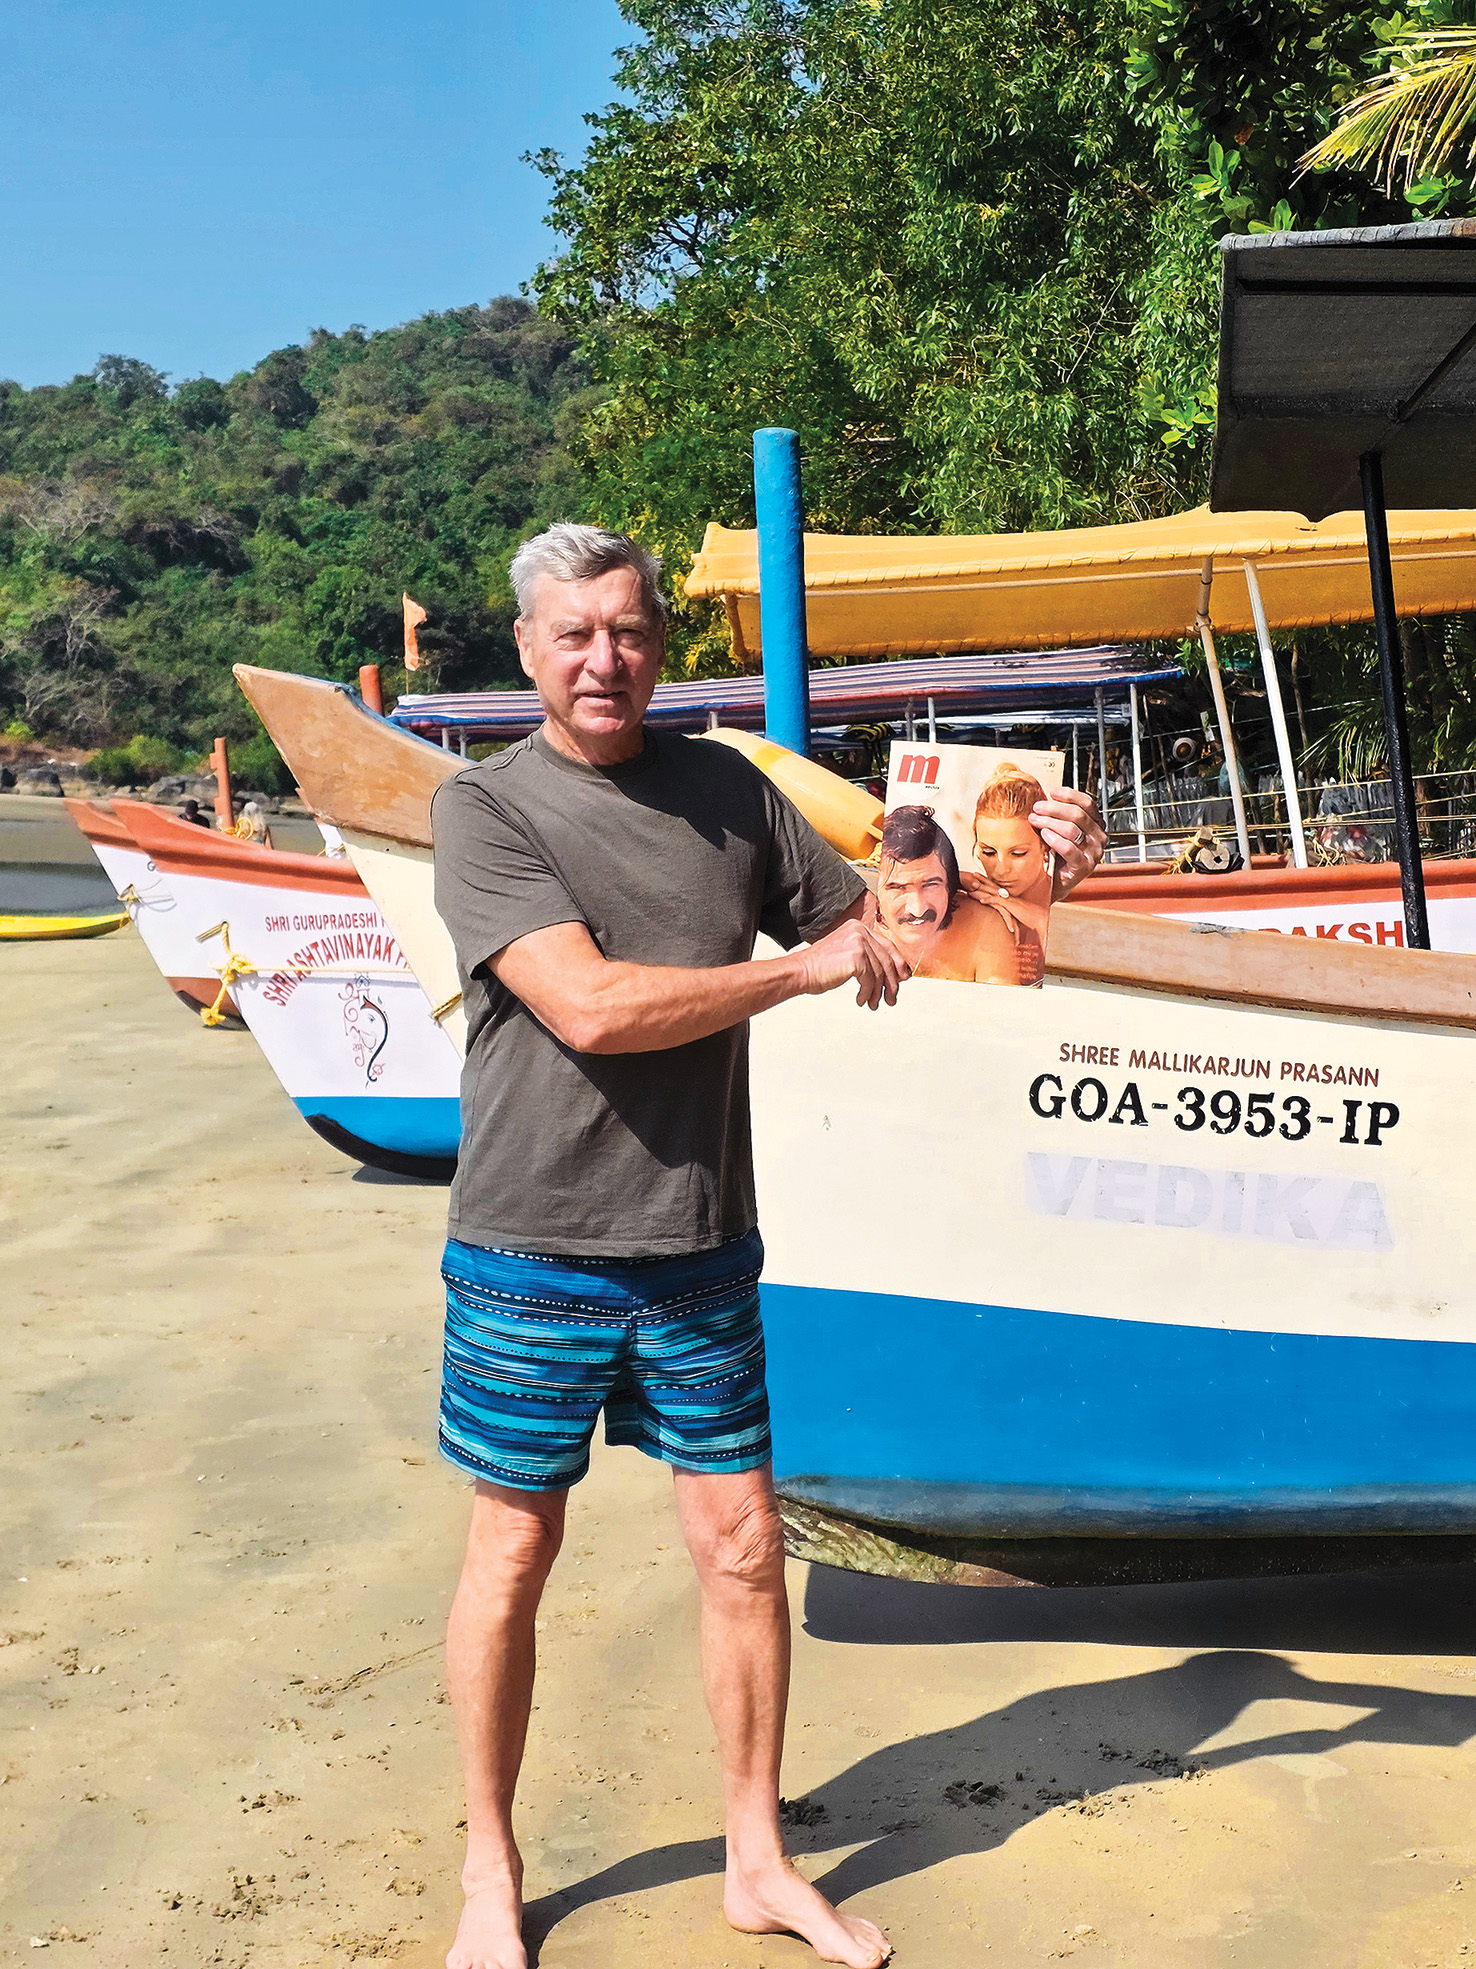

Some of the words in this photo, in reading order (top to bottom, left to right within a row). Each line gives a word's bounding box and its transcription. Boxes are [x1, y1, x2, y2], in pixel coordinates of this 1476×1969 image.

[264, 916, 290, 932] SHRI
[293, 912, 378, 931] GURUPRADESHI
[1258, 920, 1404, 947] KSH
[262, 969, 298, 1007] SHRI
[286, 933, 395, 982] ASHTAVINAYAK
[1059, 1042, 1120, 1067] SHREE
[1128, 1049, 1271, 1079] MALLIKARJUN
[1280, 1061, 1380, 1088] PRASANN
[1028, 1073, 1400, 1146] GOA-3953-IP
[1026, 1151, 1394, 1245] VEDIKA
